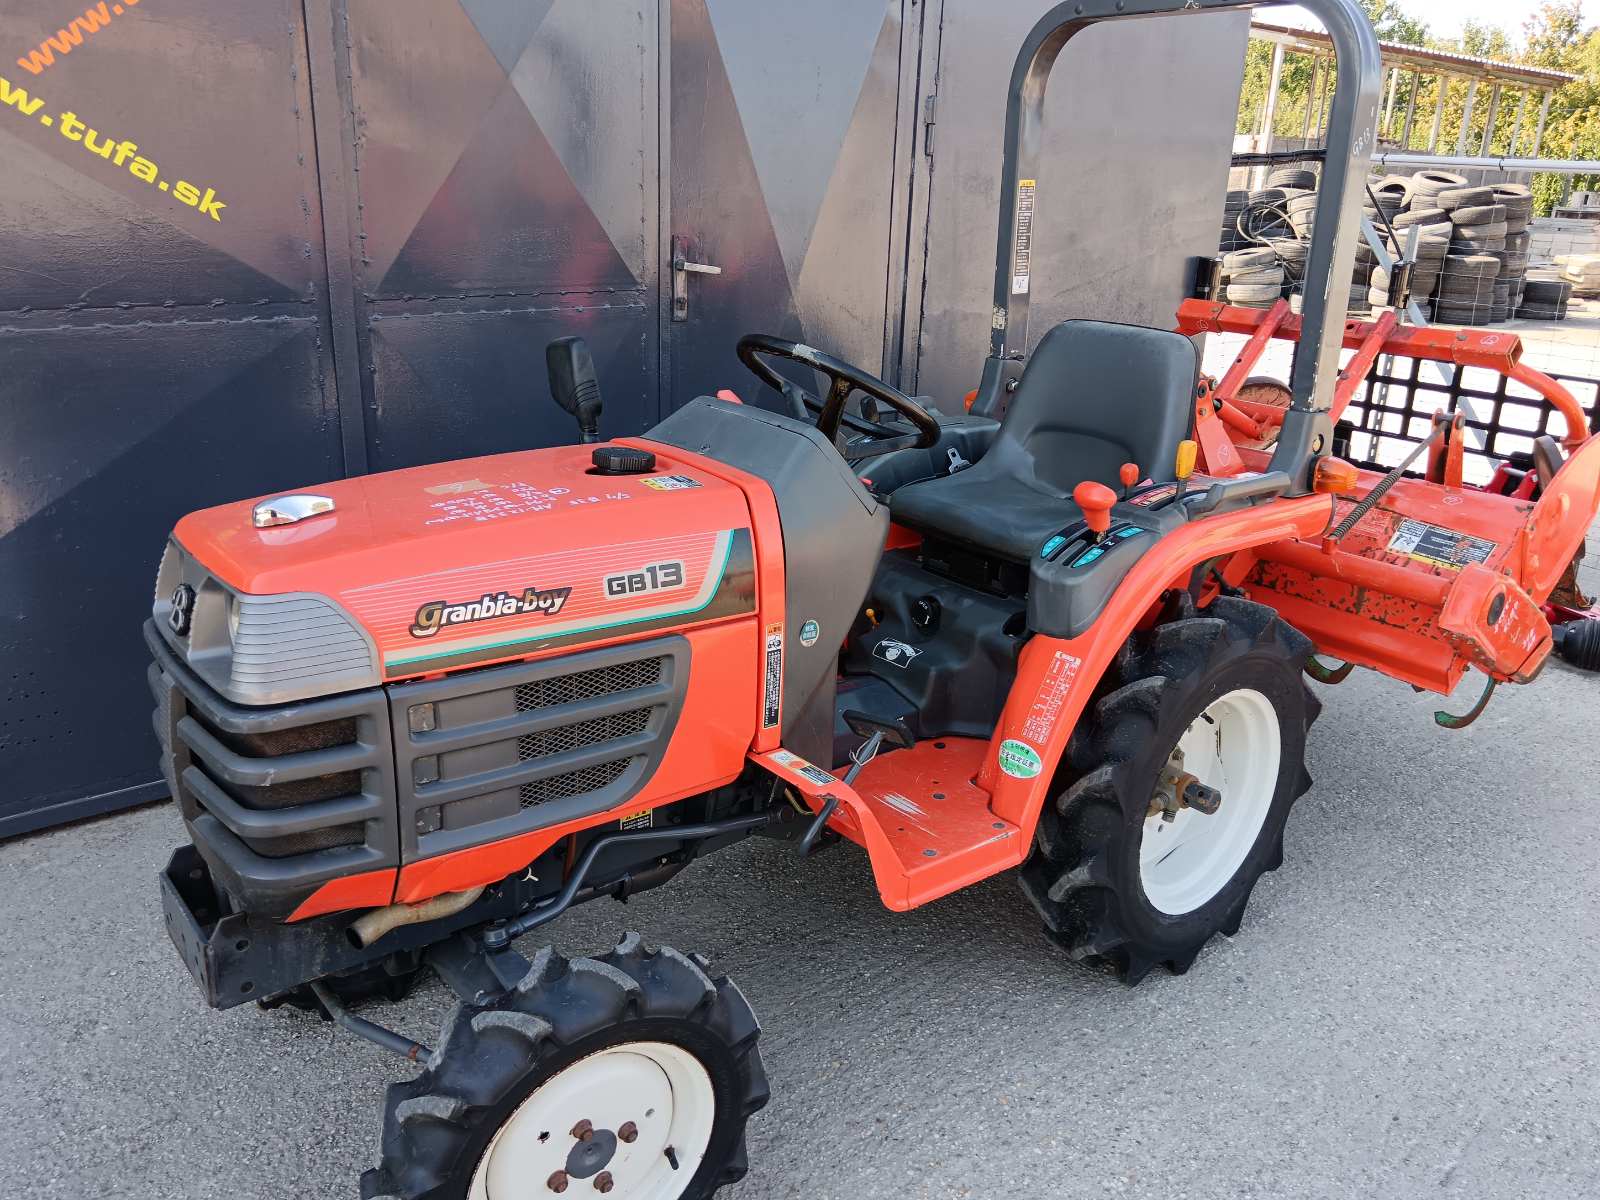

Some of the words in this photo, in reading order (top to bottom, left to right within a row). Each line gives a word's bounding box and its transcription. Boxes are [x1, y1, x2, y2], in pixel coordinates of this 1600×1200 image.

[17, 0, 140, 75] www.
[607, 562, 683, 596] GB13
[410, 588, 572, 638] granbia-boy
